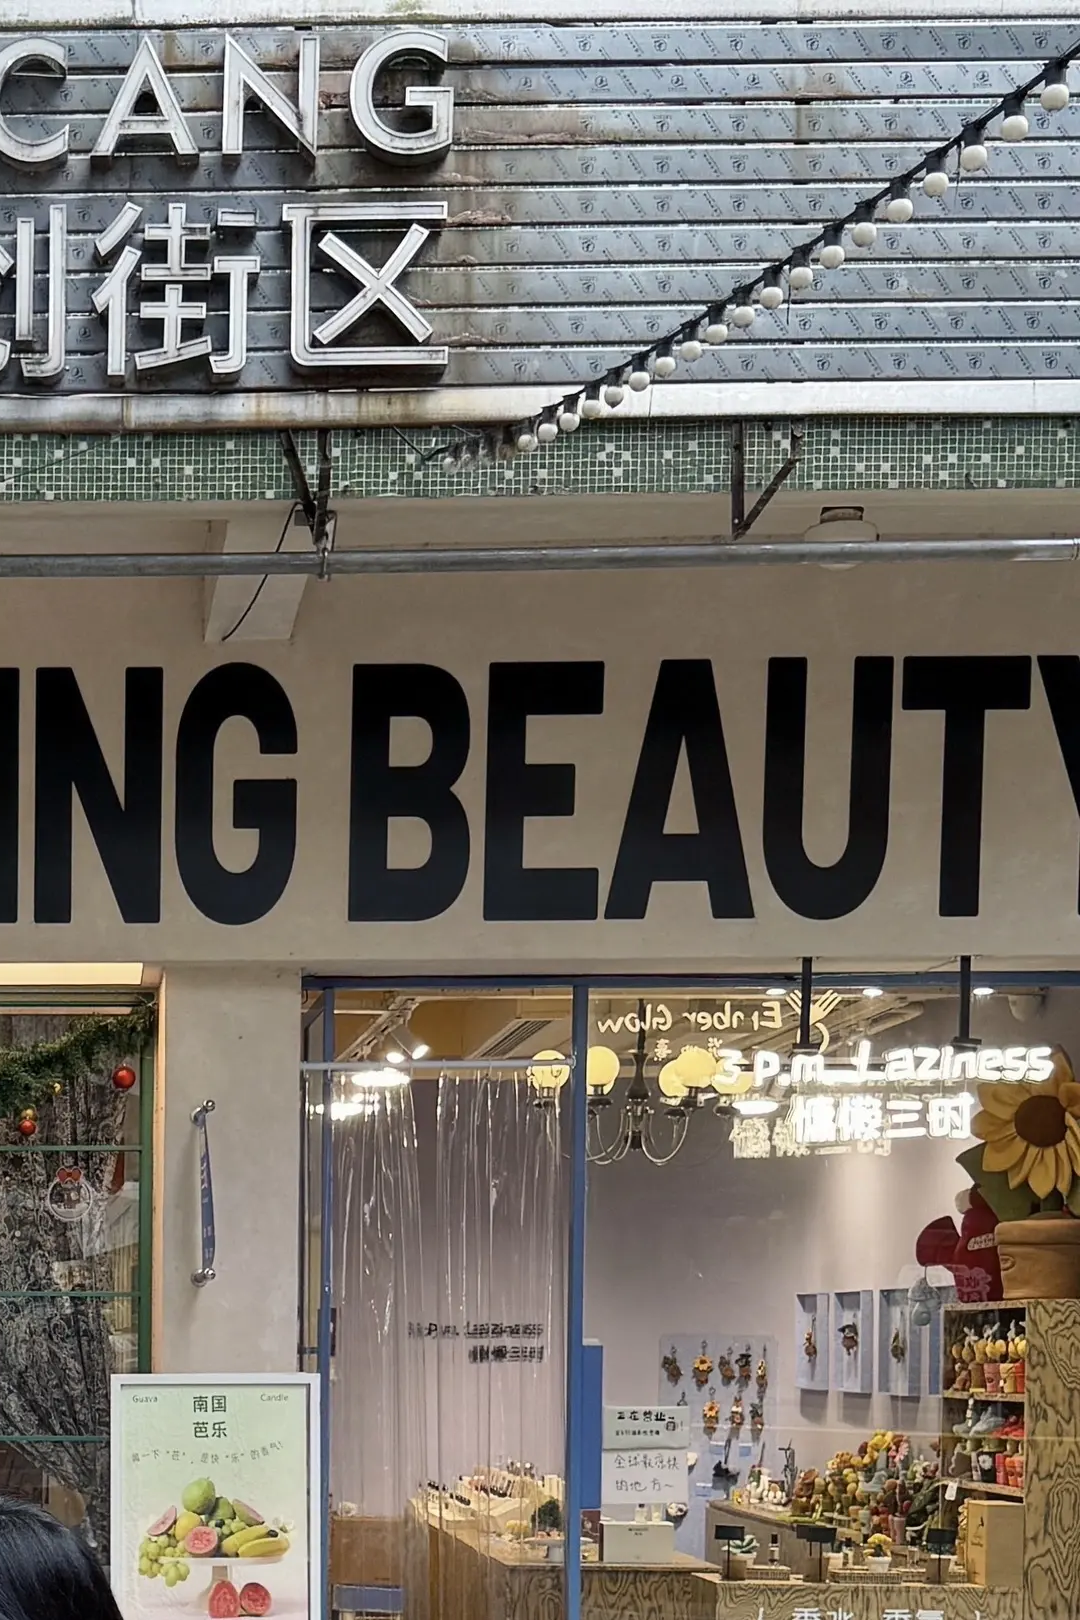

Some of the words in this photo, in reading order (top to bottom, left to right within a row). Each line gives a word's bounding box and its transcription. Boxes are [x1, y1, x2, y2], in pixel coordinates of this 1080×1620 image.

[855, 1039, 1055, 1084] Laziness
[132, 1394, 158, 1404] Guava
[260, 1393, 289, 1402] Candle
[193, 1395, 227, 1413] 南国
[192, 1421, 228, 1438] 芭乐
